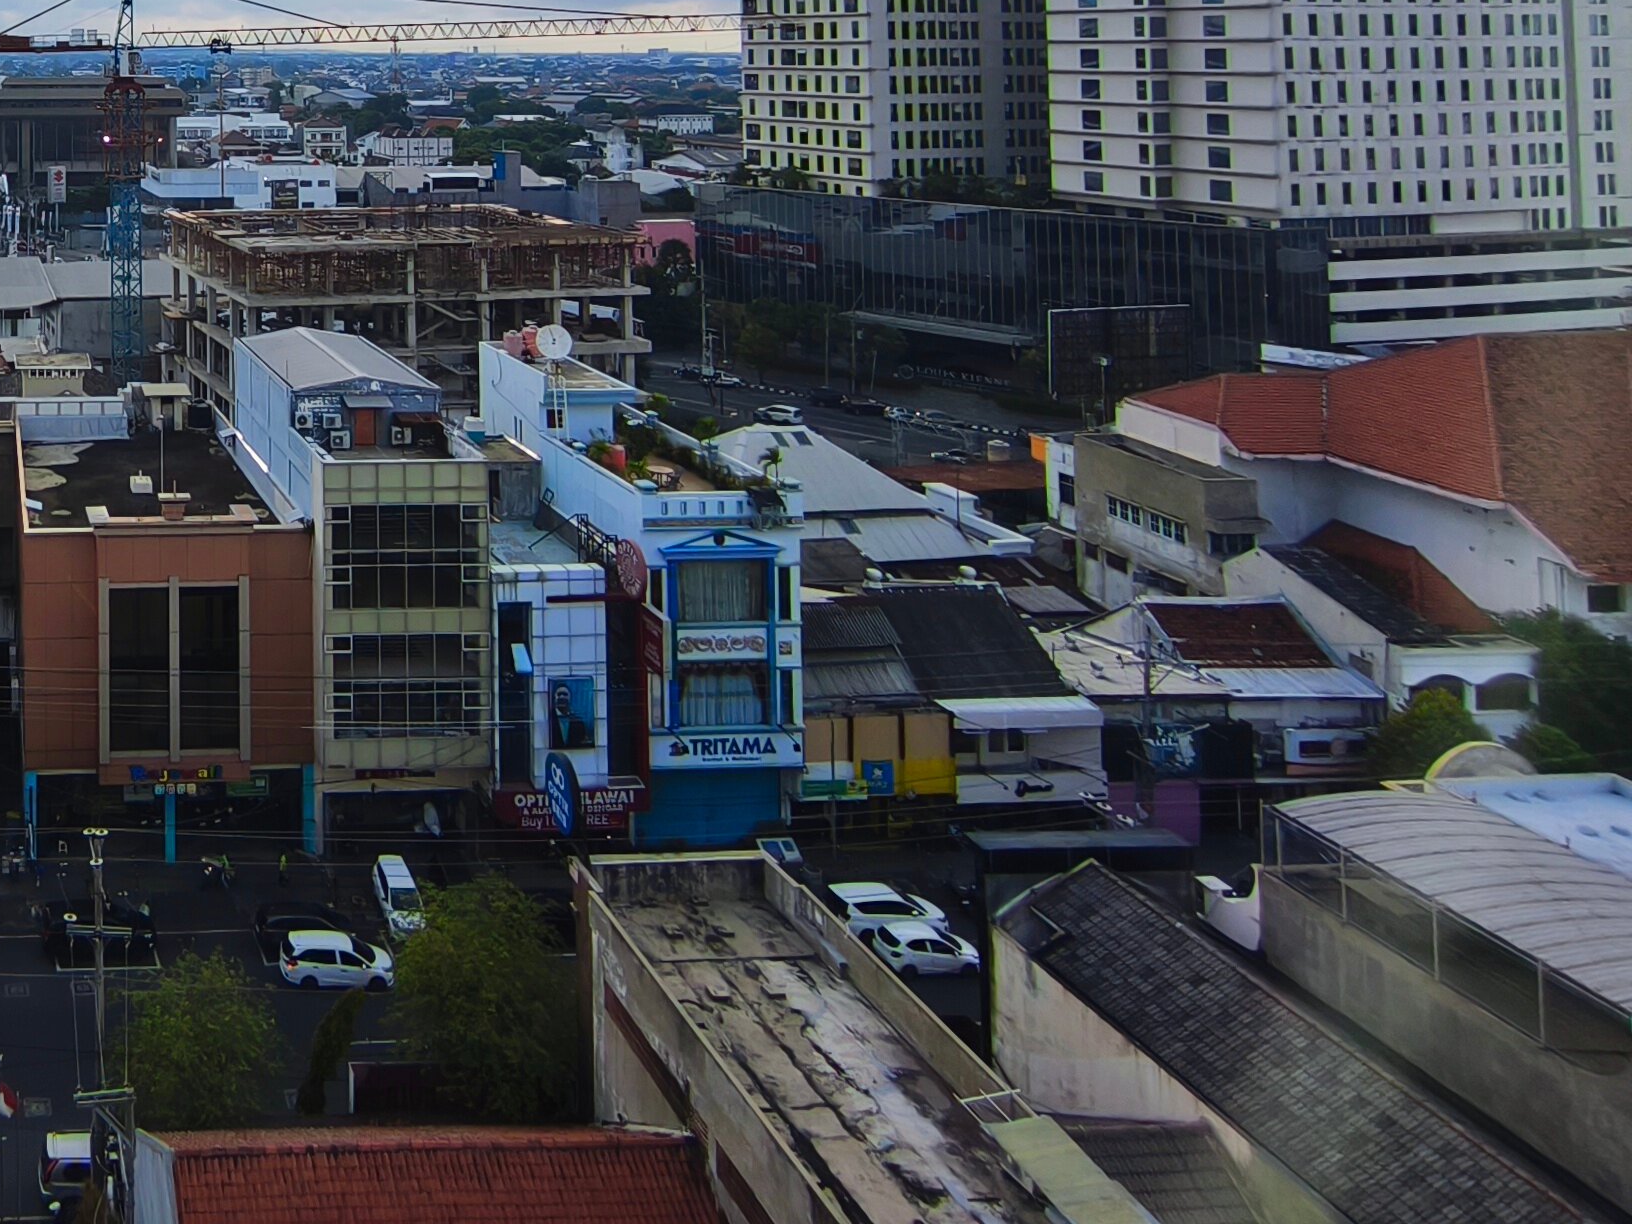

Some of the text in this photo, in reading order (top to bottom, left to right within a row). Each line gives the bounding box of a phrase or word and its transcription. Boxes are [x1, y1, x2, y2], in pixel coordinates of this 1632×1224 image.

[689, 737, 777, 756] TRITAMA
[514, 794, 549, 807] OPTI
[522, 816, 543, 829] Buy
[586, 814, 609, 825] REE
